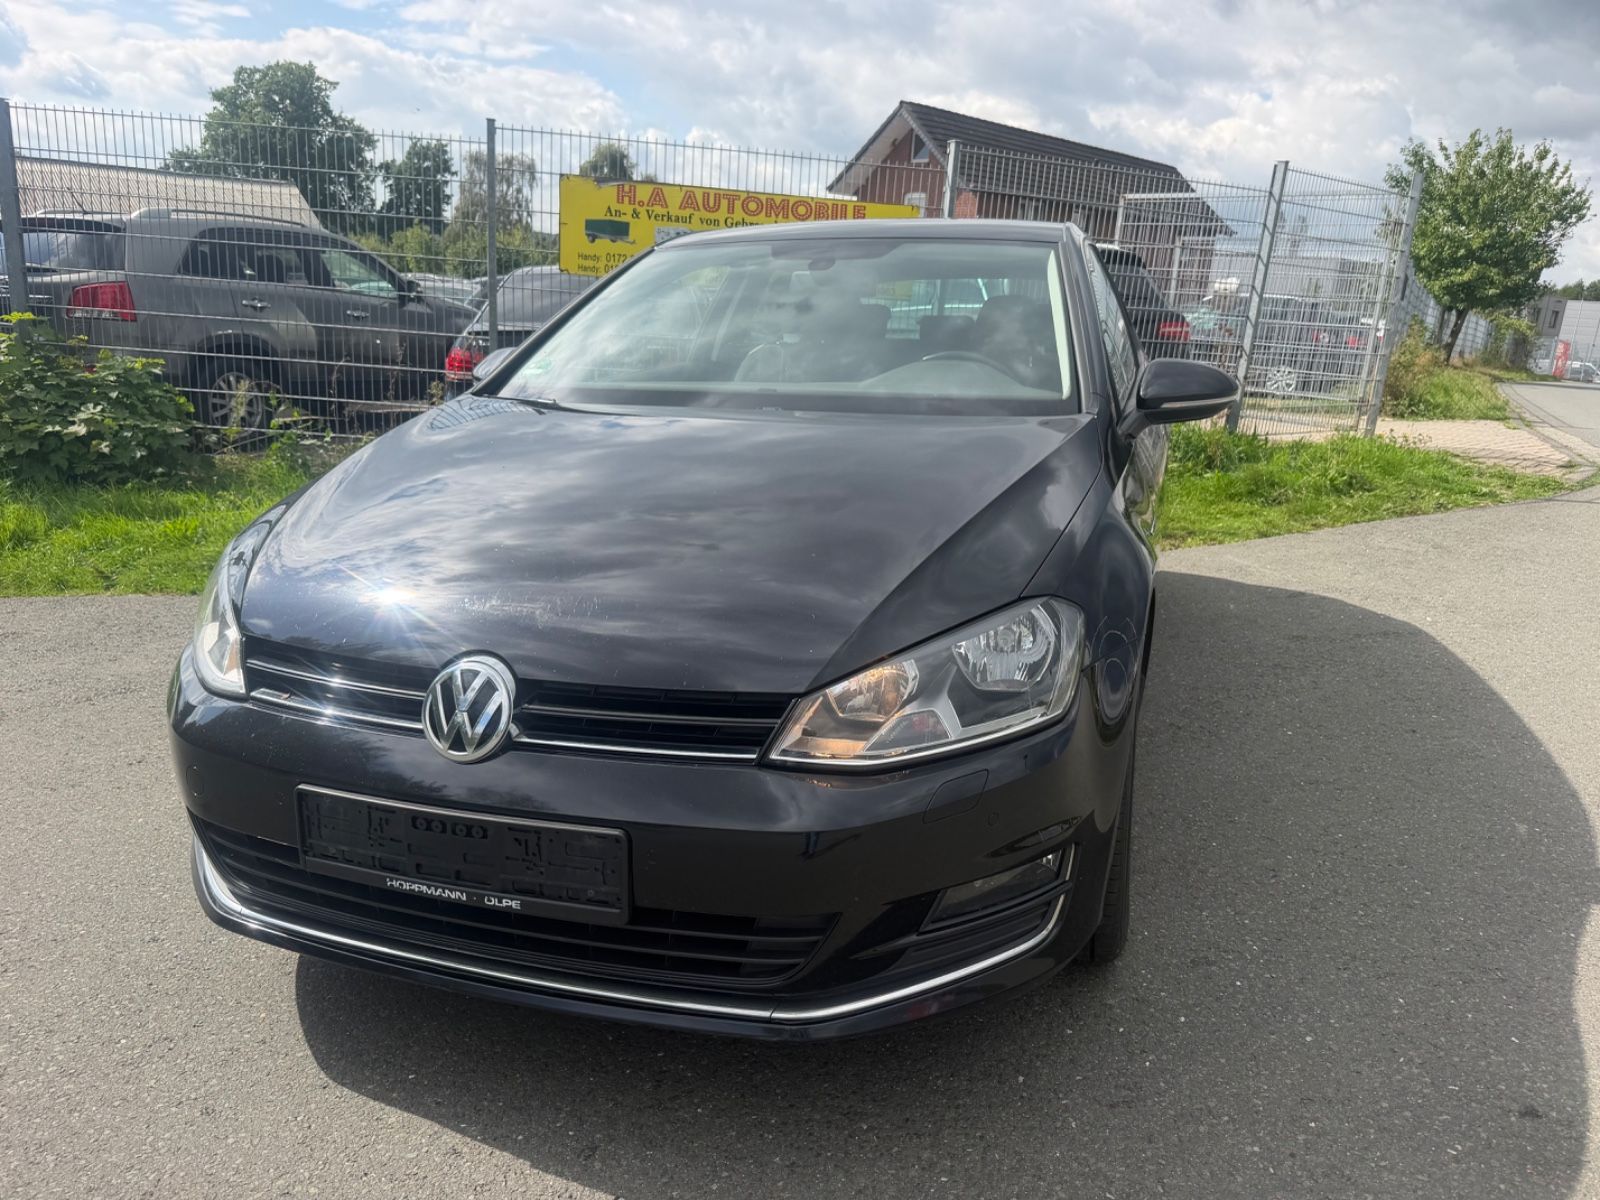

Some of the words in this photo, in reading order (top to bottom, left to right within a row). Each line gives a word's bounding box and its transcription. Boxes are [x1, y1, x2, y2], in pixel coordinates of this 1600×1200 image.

[604, 205, 627, 218] An-
[631, 208, 641, 219] &
[645, 208, 694, 225] Verkauf
[700, 217, 720, 227] von
[616, 184, 668, 209] H.A
[679, 190, 867, 221] AUTOMOBILE
[426, 661, 509, 759] VW
